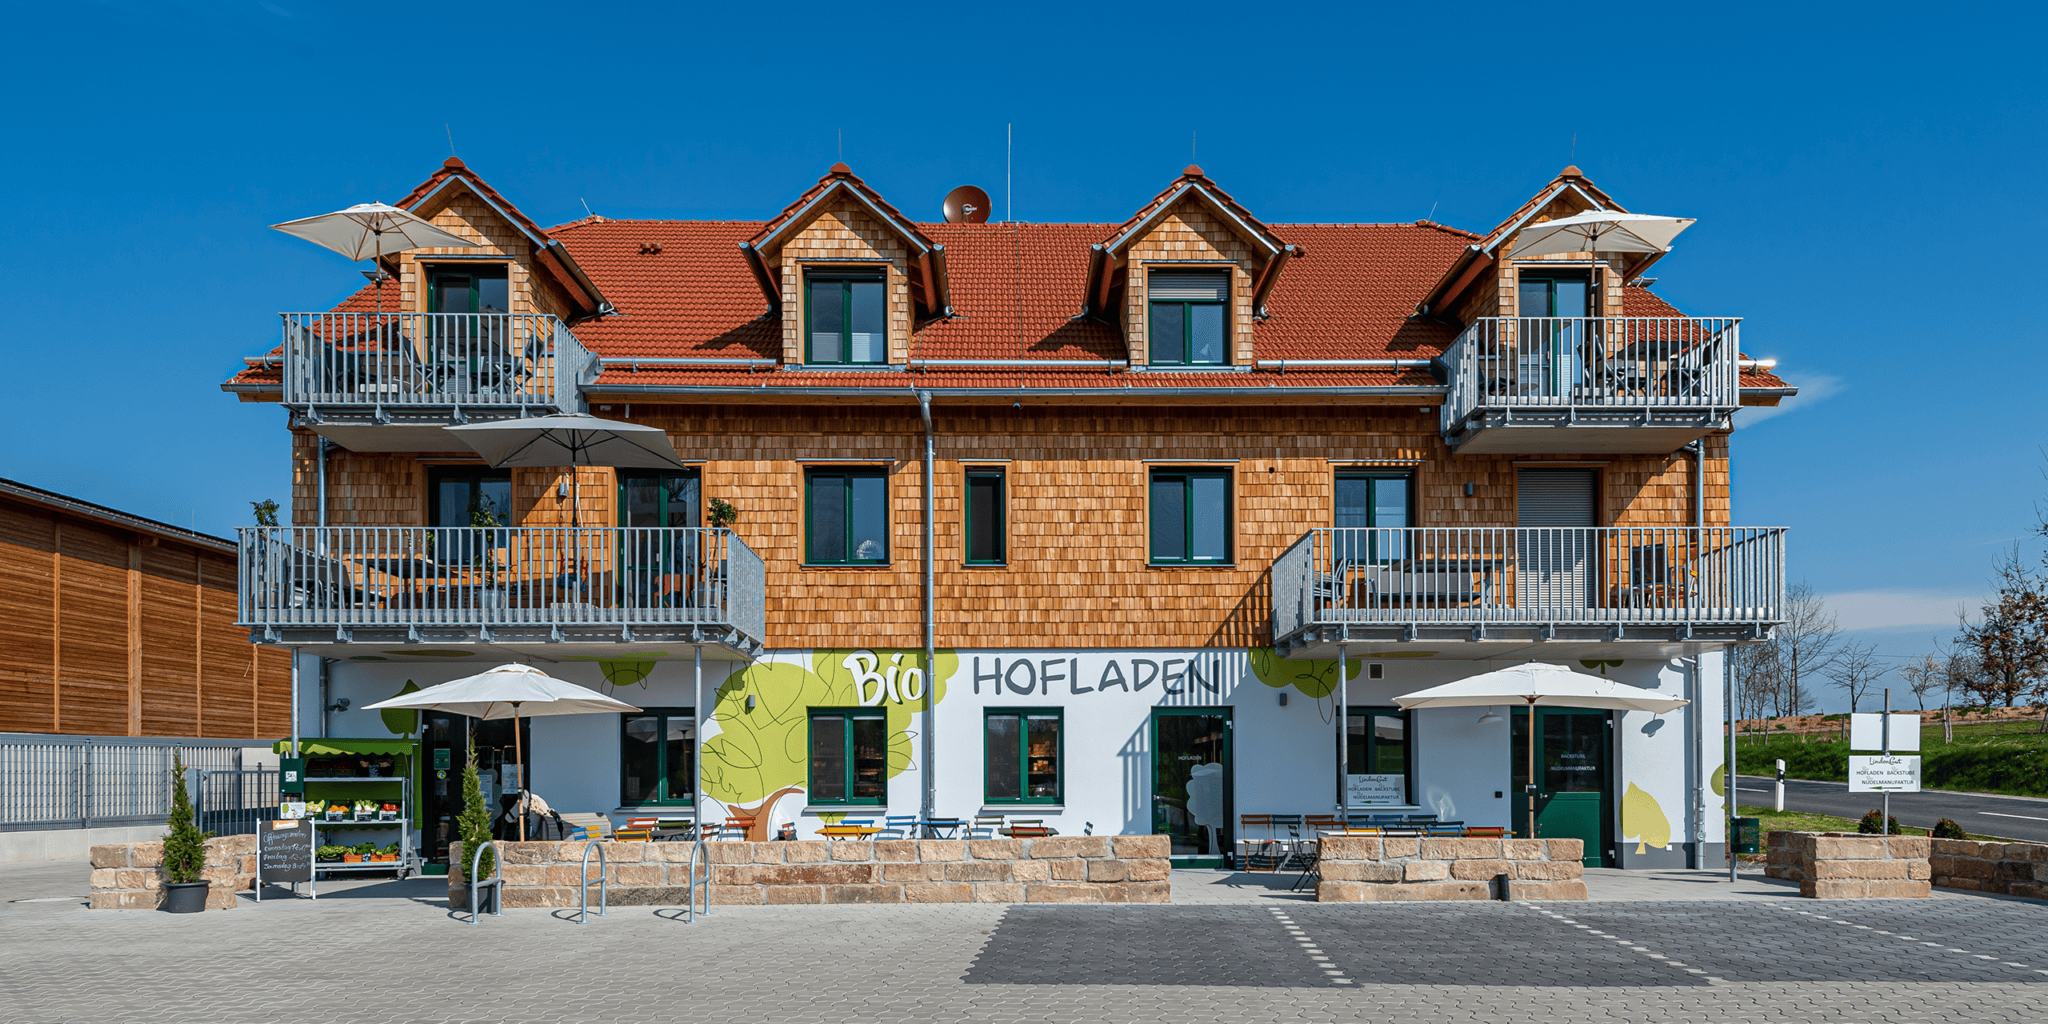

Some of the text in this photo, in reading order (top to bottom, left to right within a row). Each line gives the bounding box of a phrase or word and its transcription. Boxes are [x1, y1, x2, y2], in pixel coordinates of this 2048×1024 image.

[842, 649, 1220, 706] Bio HOFLADEN
[1869, 757, 1903, 766] LindenGut
